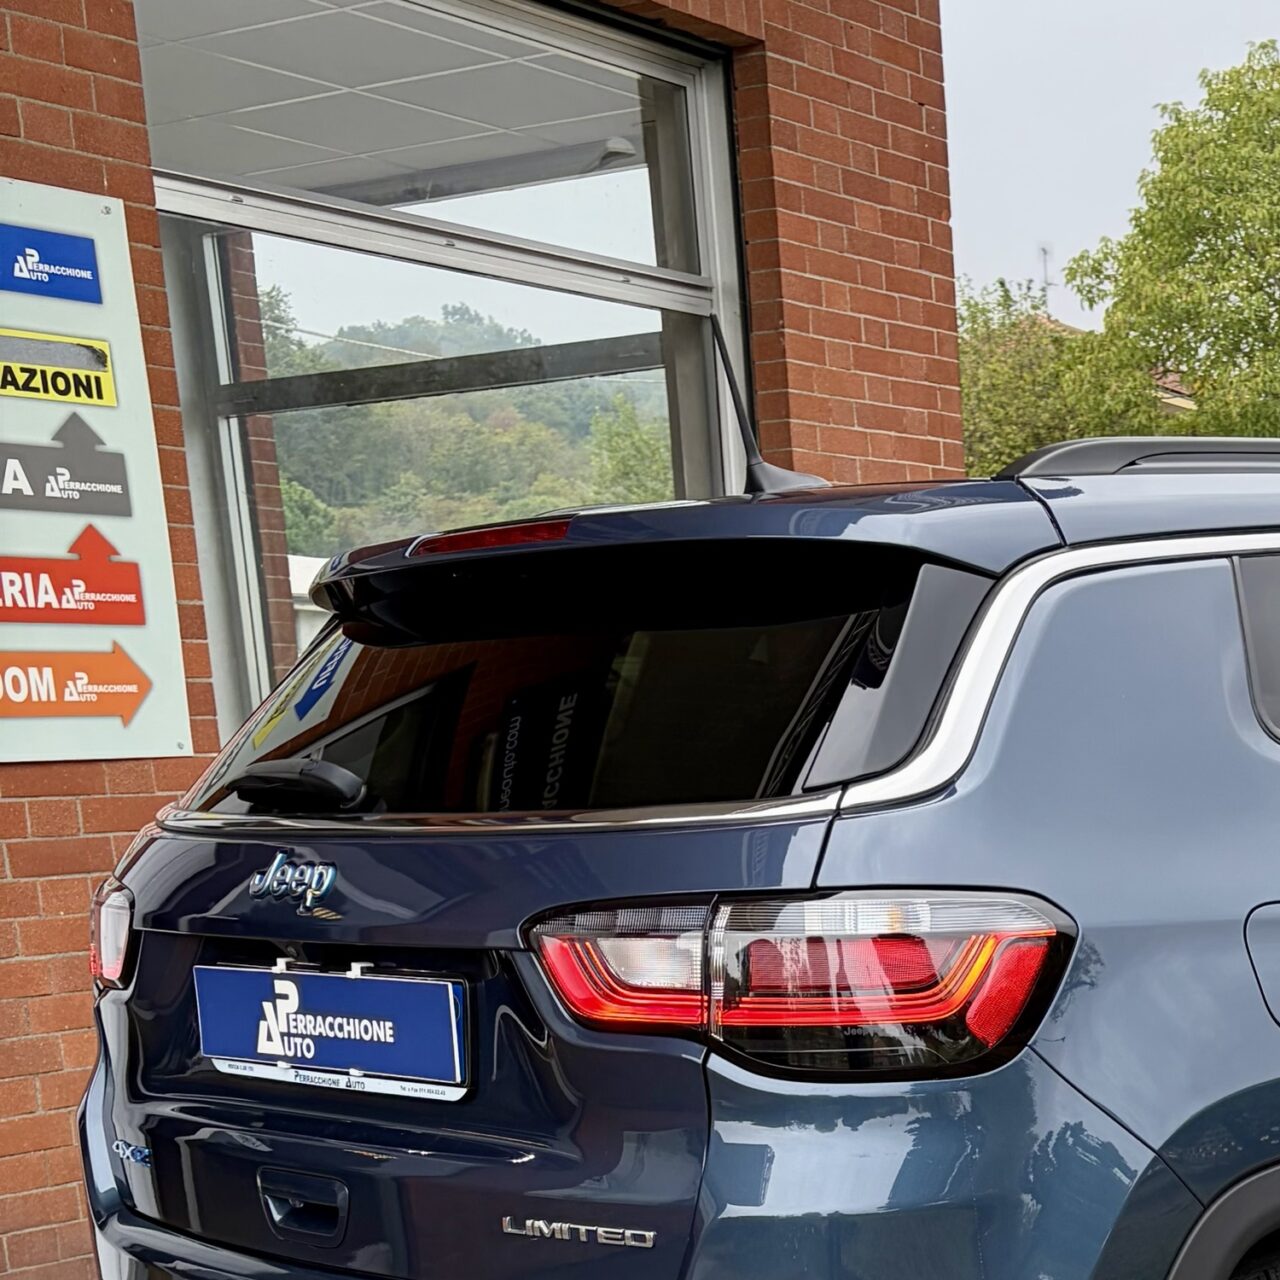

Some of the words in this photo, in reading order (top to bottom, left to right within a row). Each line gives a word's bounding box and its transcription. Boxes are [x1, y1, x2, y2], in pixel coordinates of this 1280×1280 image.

[14, 255, 49, 282] AUTO
[25, 248, 93, 280] PERRACCHIONE
[0, 365, 104, 400] AZIONI
[56, 467, 123, 493] PERRACCHIONE
[0, 571, 60, 609] RIA
[0, 666, 57, 702] OM
[249, 850, 337, 908] Jeep
[274, 979, 394, 1043] PERRACCHIONE
[257, 1001, 315, 1059] AUTO
[502, 1216, 657, 1249] LIMITED
